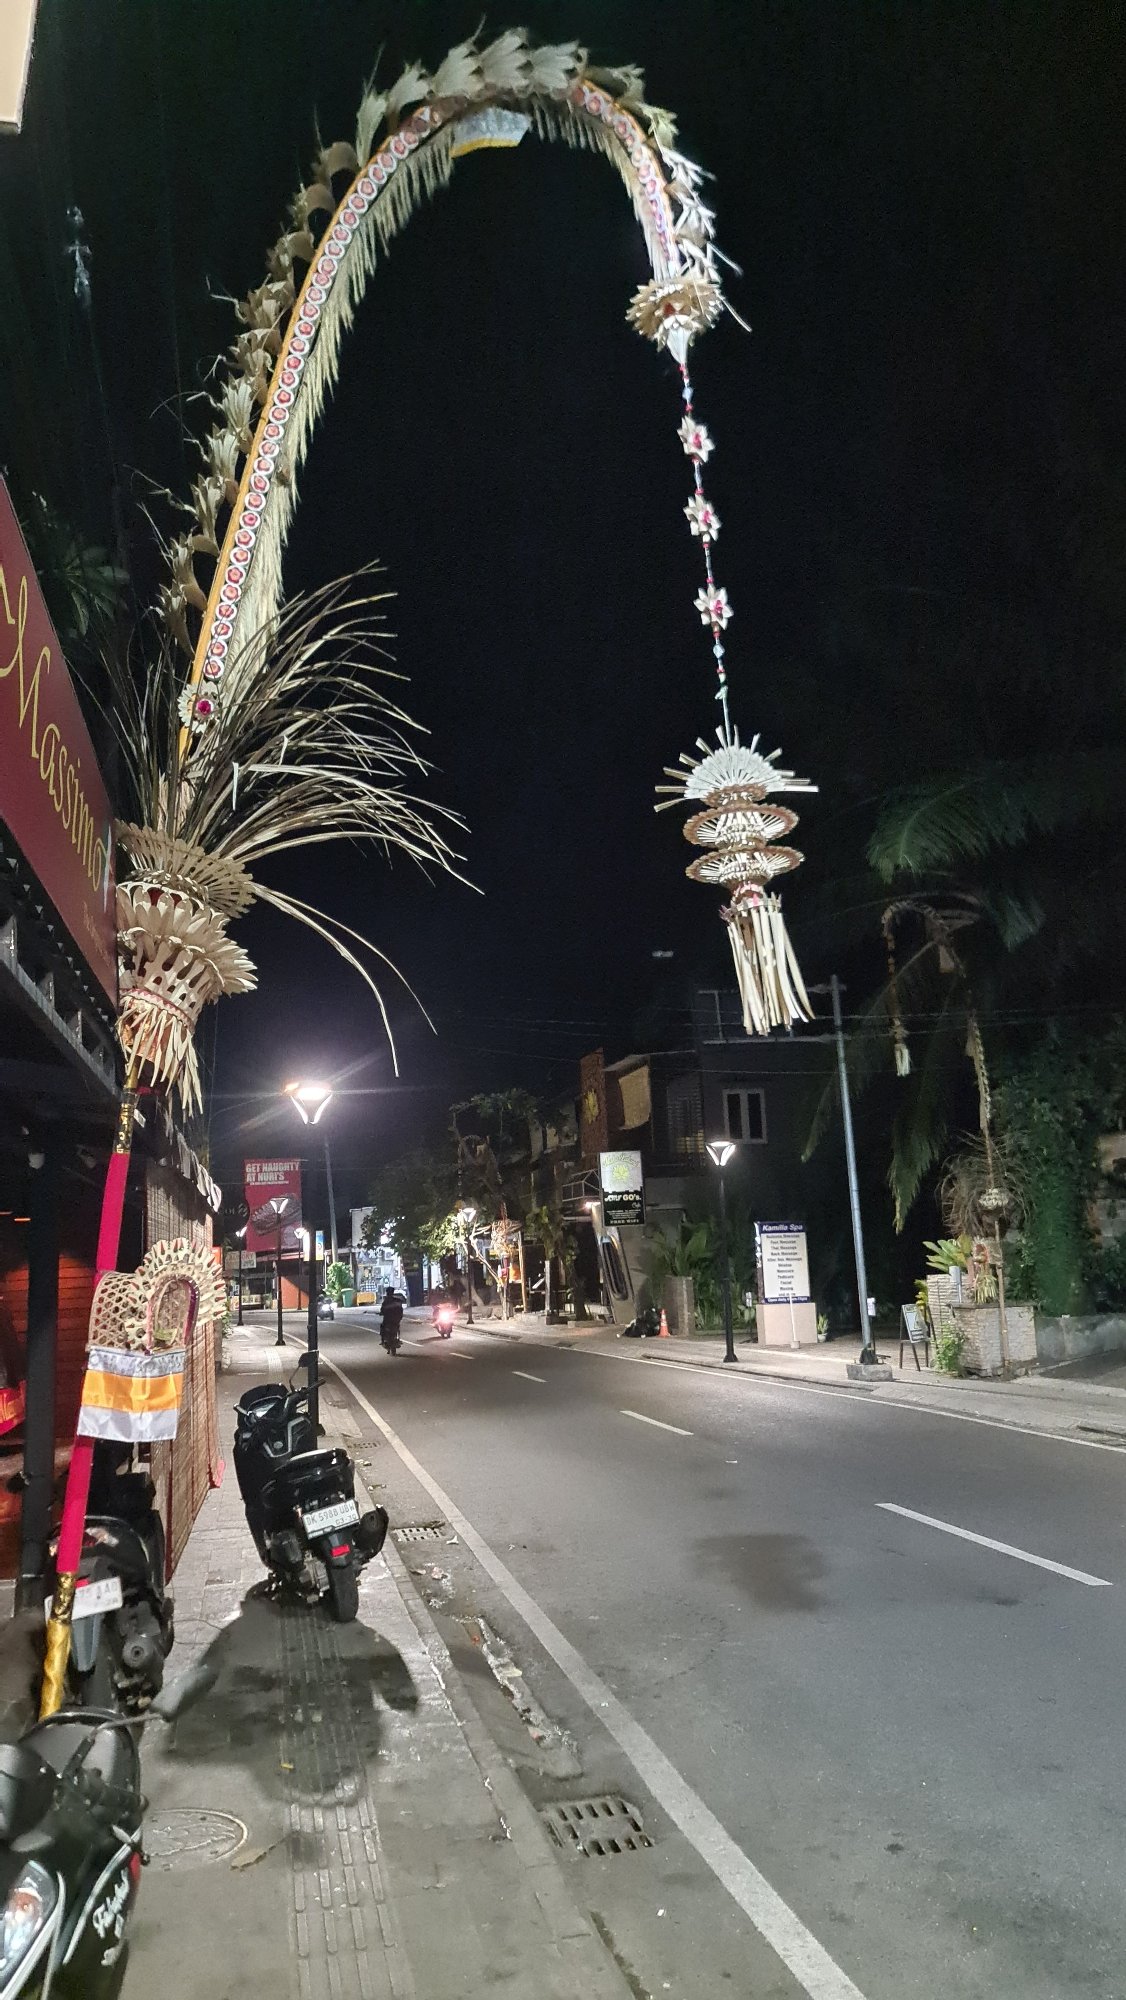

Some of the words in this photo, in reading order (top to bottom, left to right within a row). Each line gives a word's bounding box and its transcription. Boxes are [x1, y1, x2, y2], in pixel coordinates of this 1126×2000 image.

[0, 576, 113, 892] Massimo
[246, 1163, 260, 1172] GET
[262, 1161, 300, 1172] NAUGHTY
[246, 1172, 256, 1182] AT
[789, 1223, 803, 1232] Spa
[306, 1514, 317, 1526] DK
